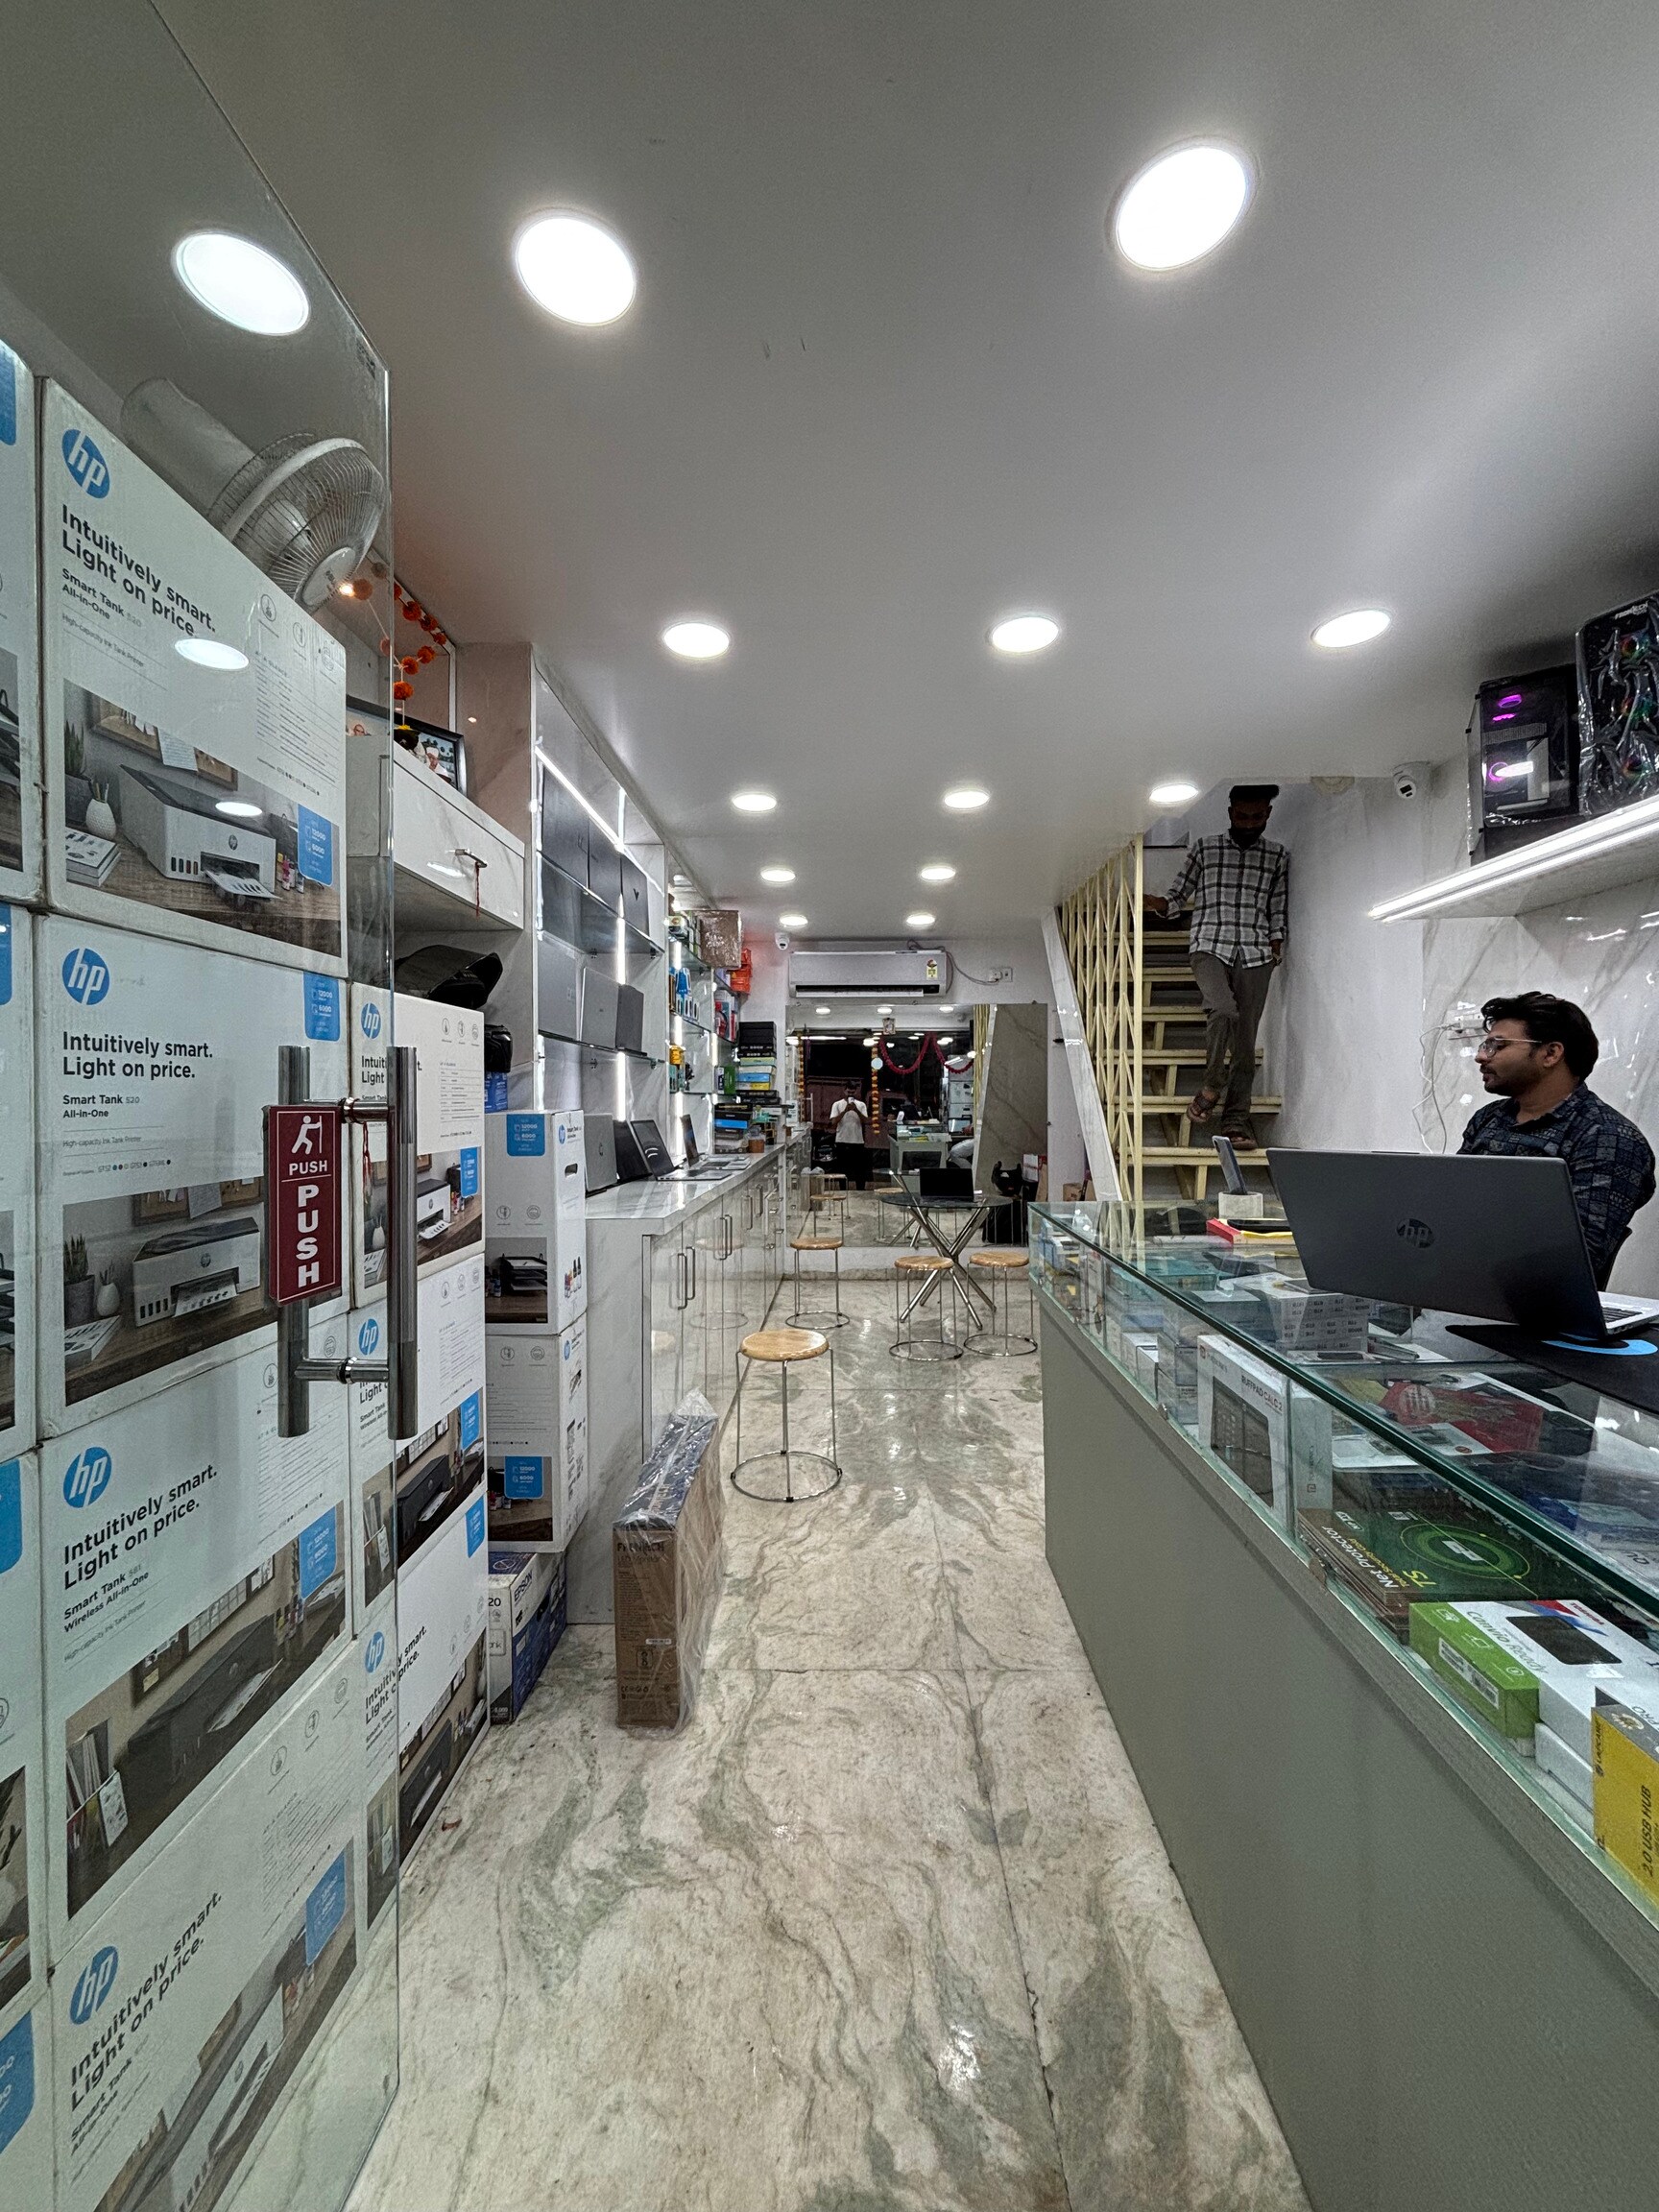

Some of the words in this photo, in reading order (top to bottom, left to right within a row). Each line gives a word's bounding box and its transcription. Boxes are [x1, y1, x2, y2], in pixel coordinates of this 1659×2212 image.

[61, 428, 110, 499] hp
[62, 529, 116, 584] Light
[123, 578, 146, 604] on
[62, 503, 161, 593] Intuitively
[167, 587, 215, 633] smart.
[62, 568, 97, 598] Smart
[100, 592, 125, 616] Tank
[62, 584, 110, 619] All-in-One
[61, 947, 110, 1006] hp
[360, 1002, 381, 1040] hp
[62, 1031, 160, 1058] Intuitively
[164, 1041, 213, 1058] smart.
[62, 1056, 116, 1079] Light
[122, 1061, 144, 1077] on
[151, 1060, 196, 1081] price.
[62, 1094, 96, 1105] Smart
[99, 1094, 123, 1104] Tank
[62, 1109, 109, 1118] All-in-One
[288, 1159, 328, 1176] PUSH
[295, 1184, 320, 1288] PUSH
[358, 1318, 379, 1356] hp
[62, 1446, 112, 1509] hp
[64, 1495, 163, 1565] Intuitively
[168, 1464, 217, 1503] smart.
[64, 1545, 118, 1590] Light
[124, 1527, 148, 1551] on
[154, 1498, 200, 1538] price.
[1321, 1526, 1375, 1569] Protector
[64, 1591, 98, 1620] Smart
[101, 1573, 126, 1595] Tank
[514, 1570, 533, 1602] EPSON
[1369, 1570, 1399, 1588] Net
[64, 1602, 105, 1633] Wireless
[106, 1572, 149, 1606] All-in-One
[1467, 1611, 1510, 1643] Canvio
[365, 1631, 385, 1673] hp
[1641, 1785, 1651, 1819] HUB
[1642, 1818, 1652, 1851] USB
[69, 1945, 119, 2026] hp
[71, 1955, 168, 2087] Intuitively
[173, 1892, 222, 1958] smart.
[71, 2032, 126, 2112] Light
[131, 1997, 154, 2032] on
[158, 1937, 204, 2002] price.
